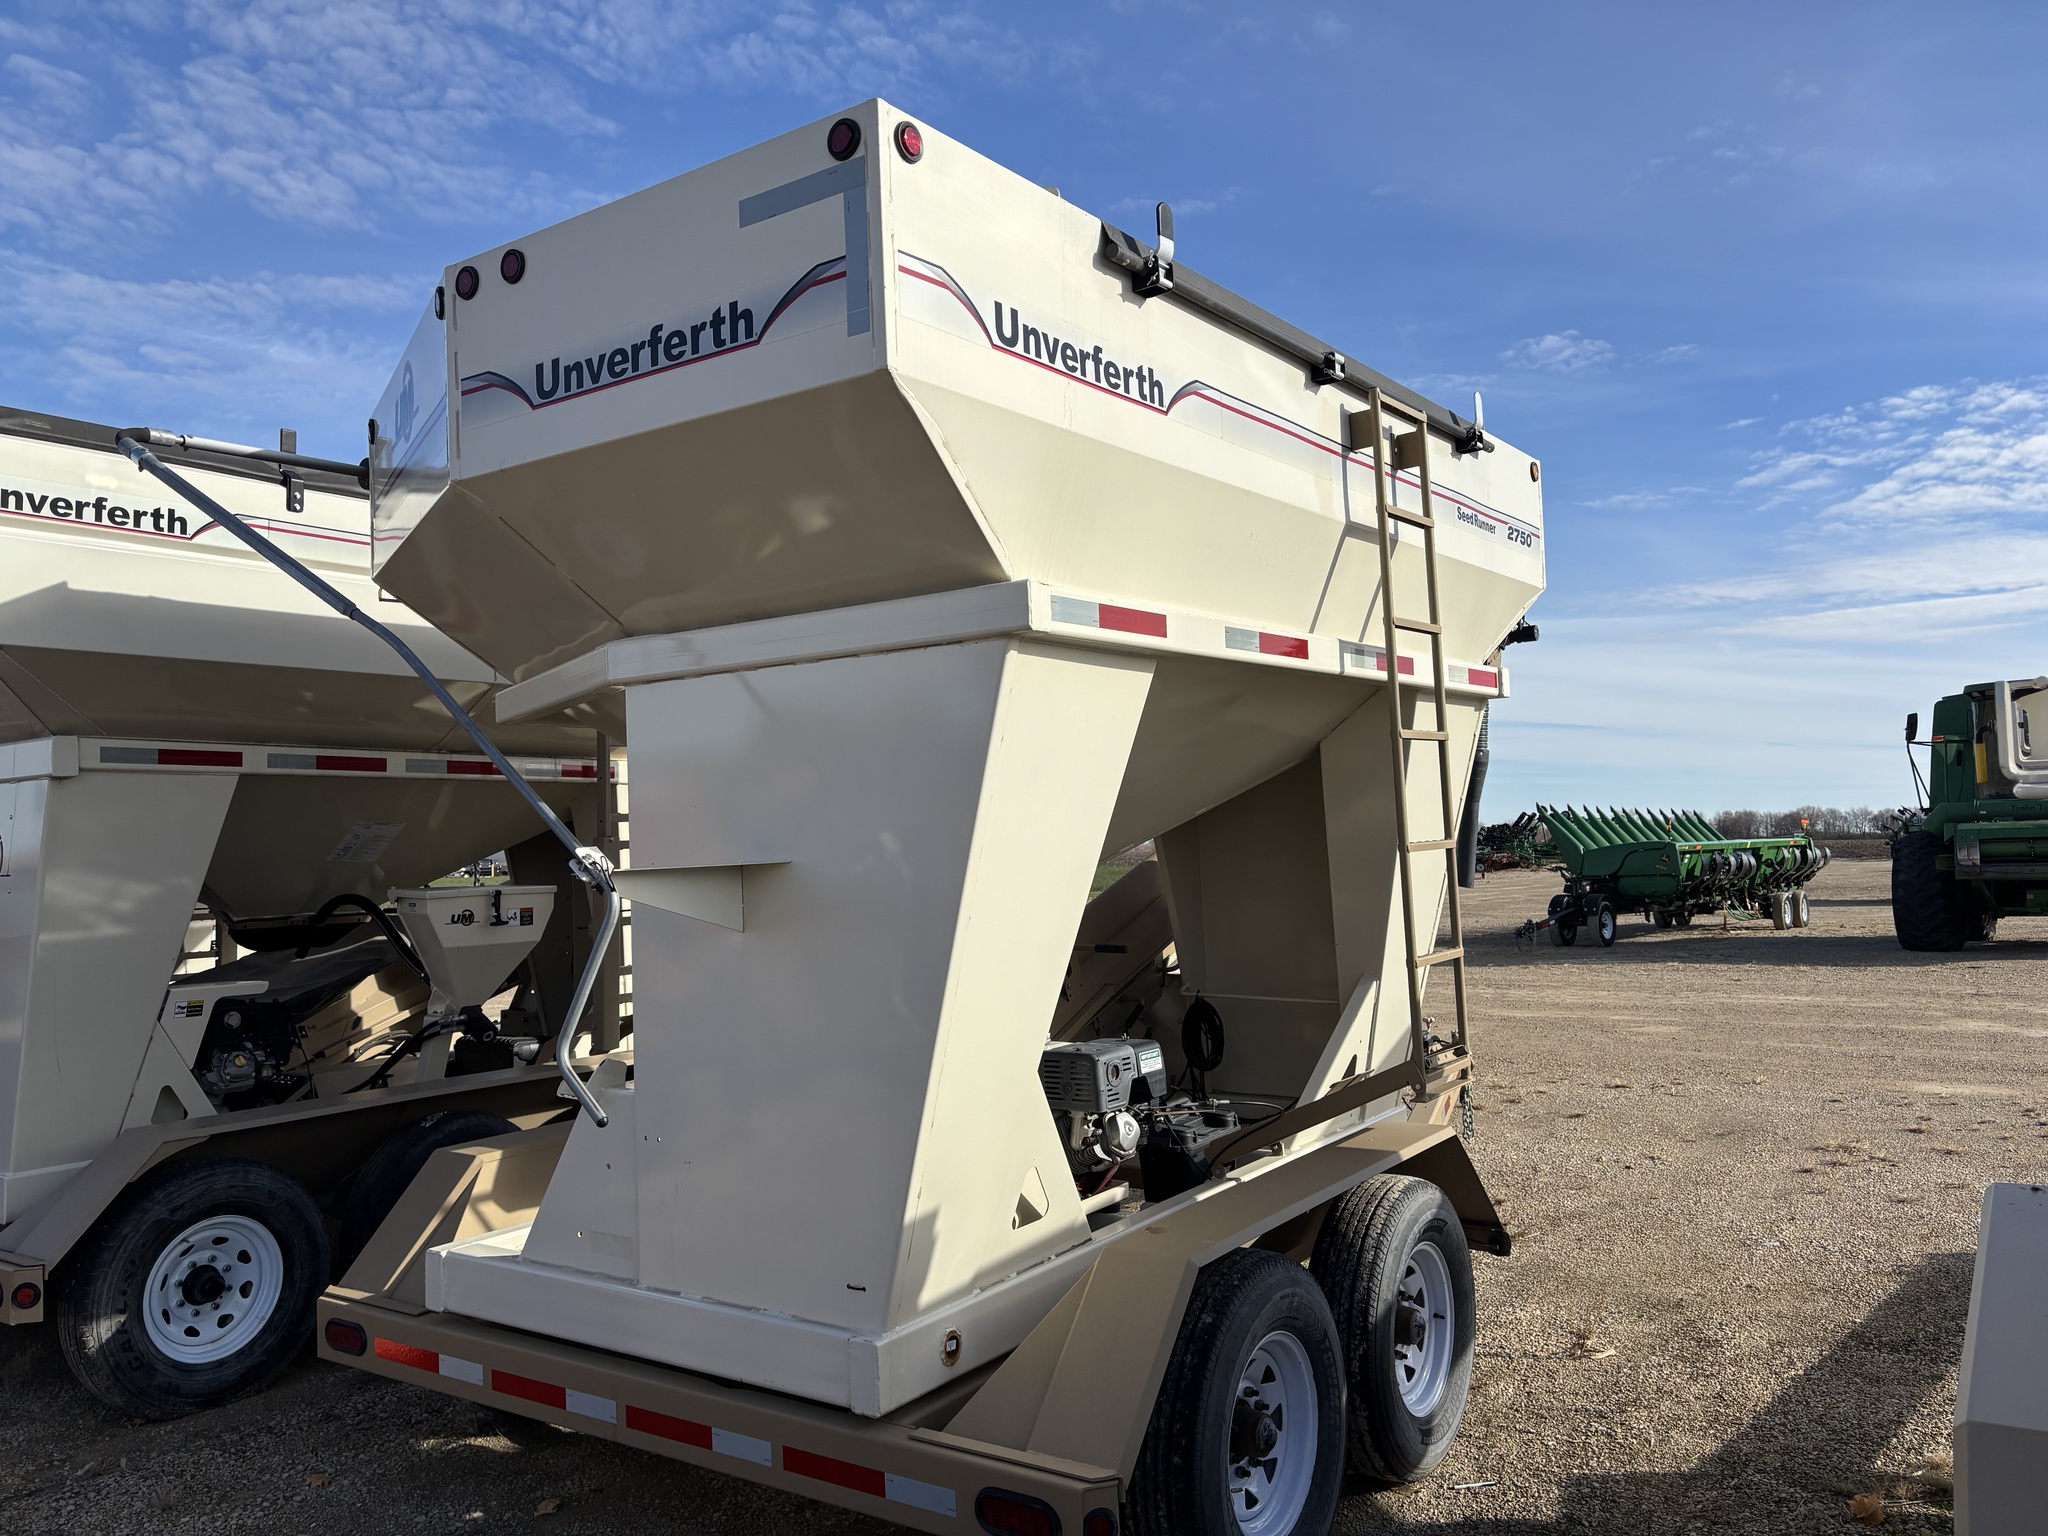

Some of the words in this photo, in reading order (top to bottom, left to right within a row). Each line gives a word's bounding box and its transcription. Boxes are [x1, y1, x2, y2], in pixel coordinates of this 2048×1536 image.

[534, 300, 755, 401] Unverferth
[990, 299, 1164, 408] Unverferth
[1507, 525, 1532, 548] 2750
[450, 910, 474, 925] UM
